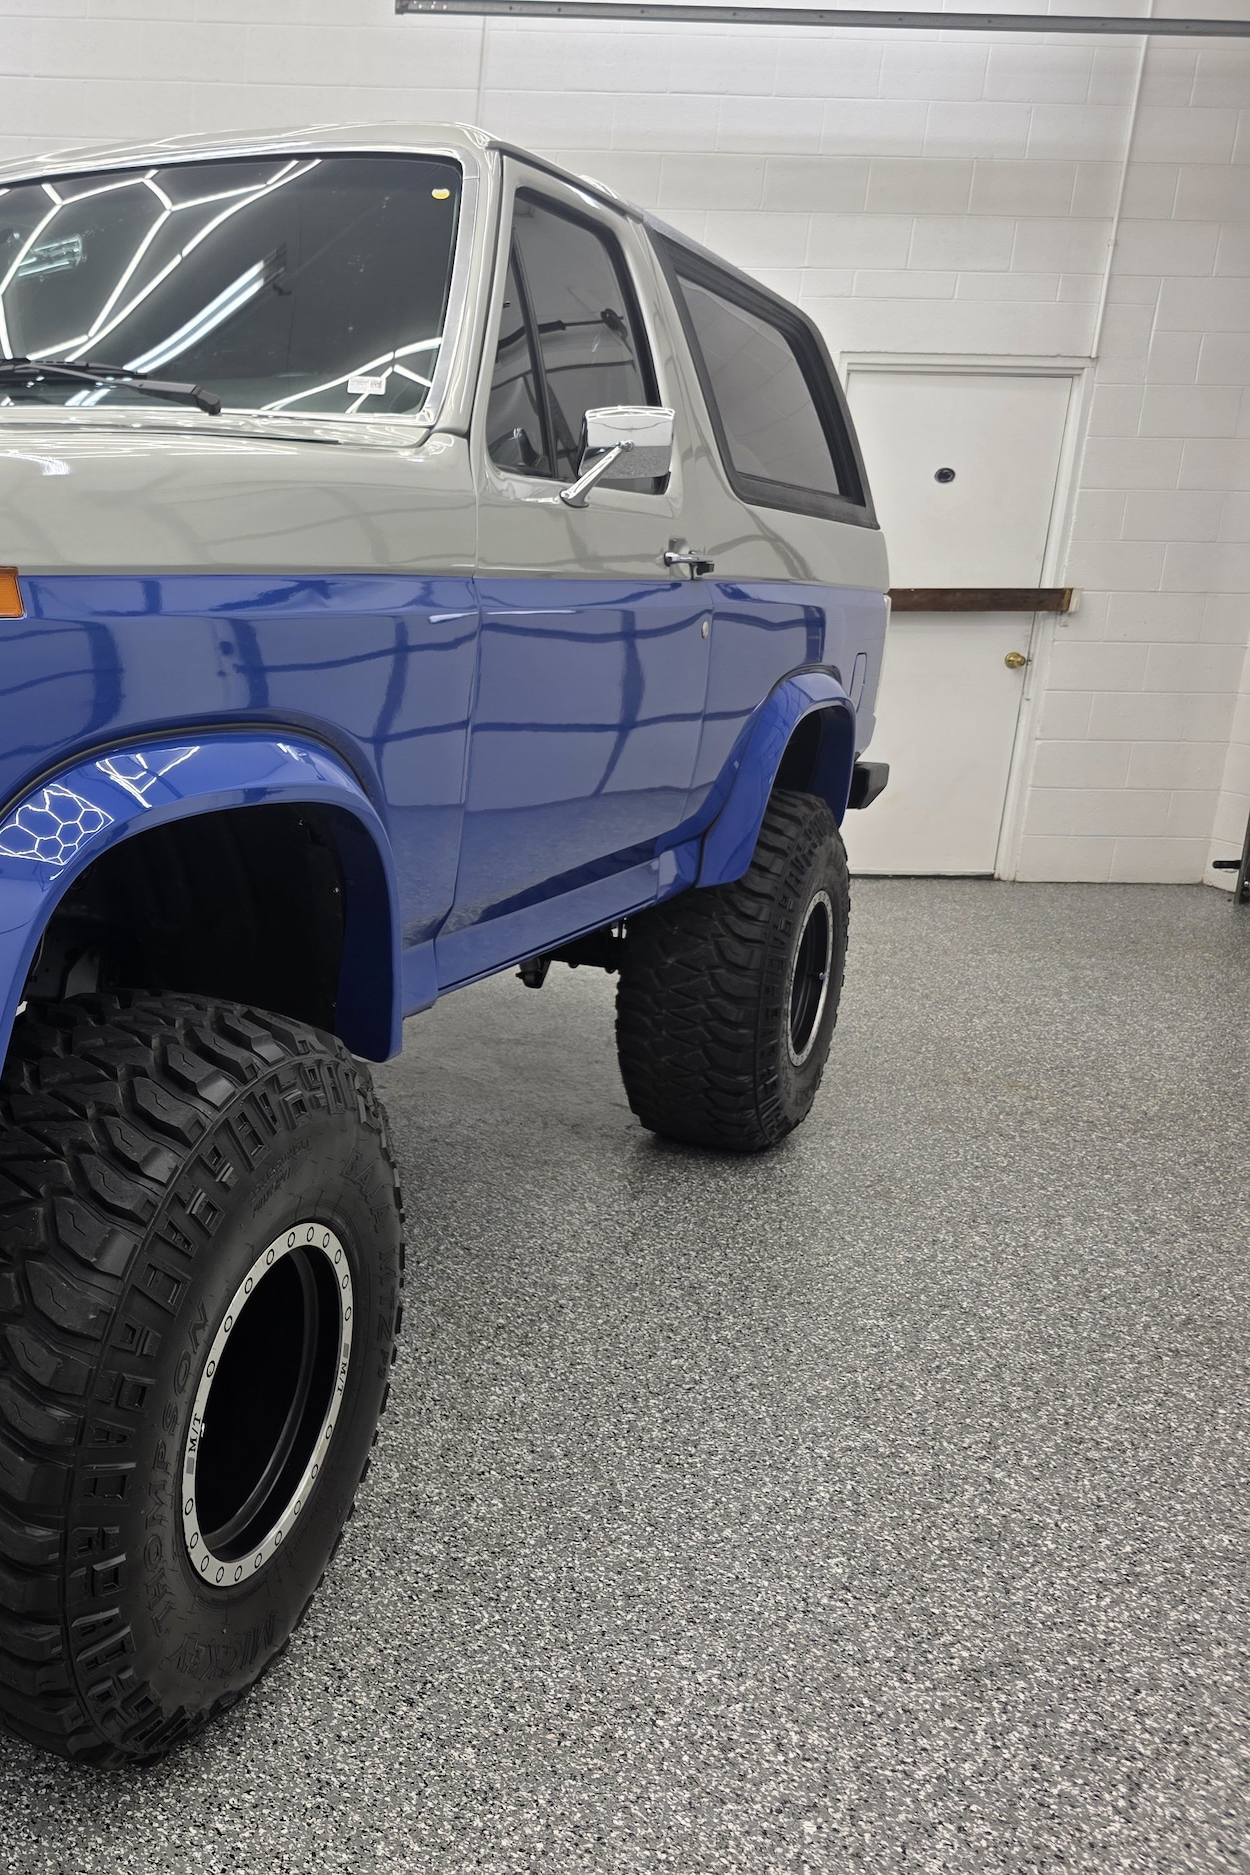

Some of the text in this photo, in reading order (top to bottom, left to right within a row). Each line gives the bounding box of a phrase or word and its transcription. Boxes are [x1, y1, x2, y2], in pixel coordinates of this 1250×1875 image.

[337, 1361, 348, 1396] M/T
[187, 1412, 202, 1453] M/T
[143, 1300, 209, 1638] THOMPSON
